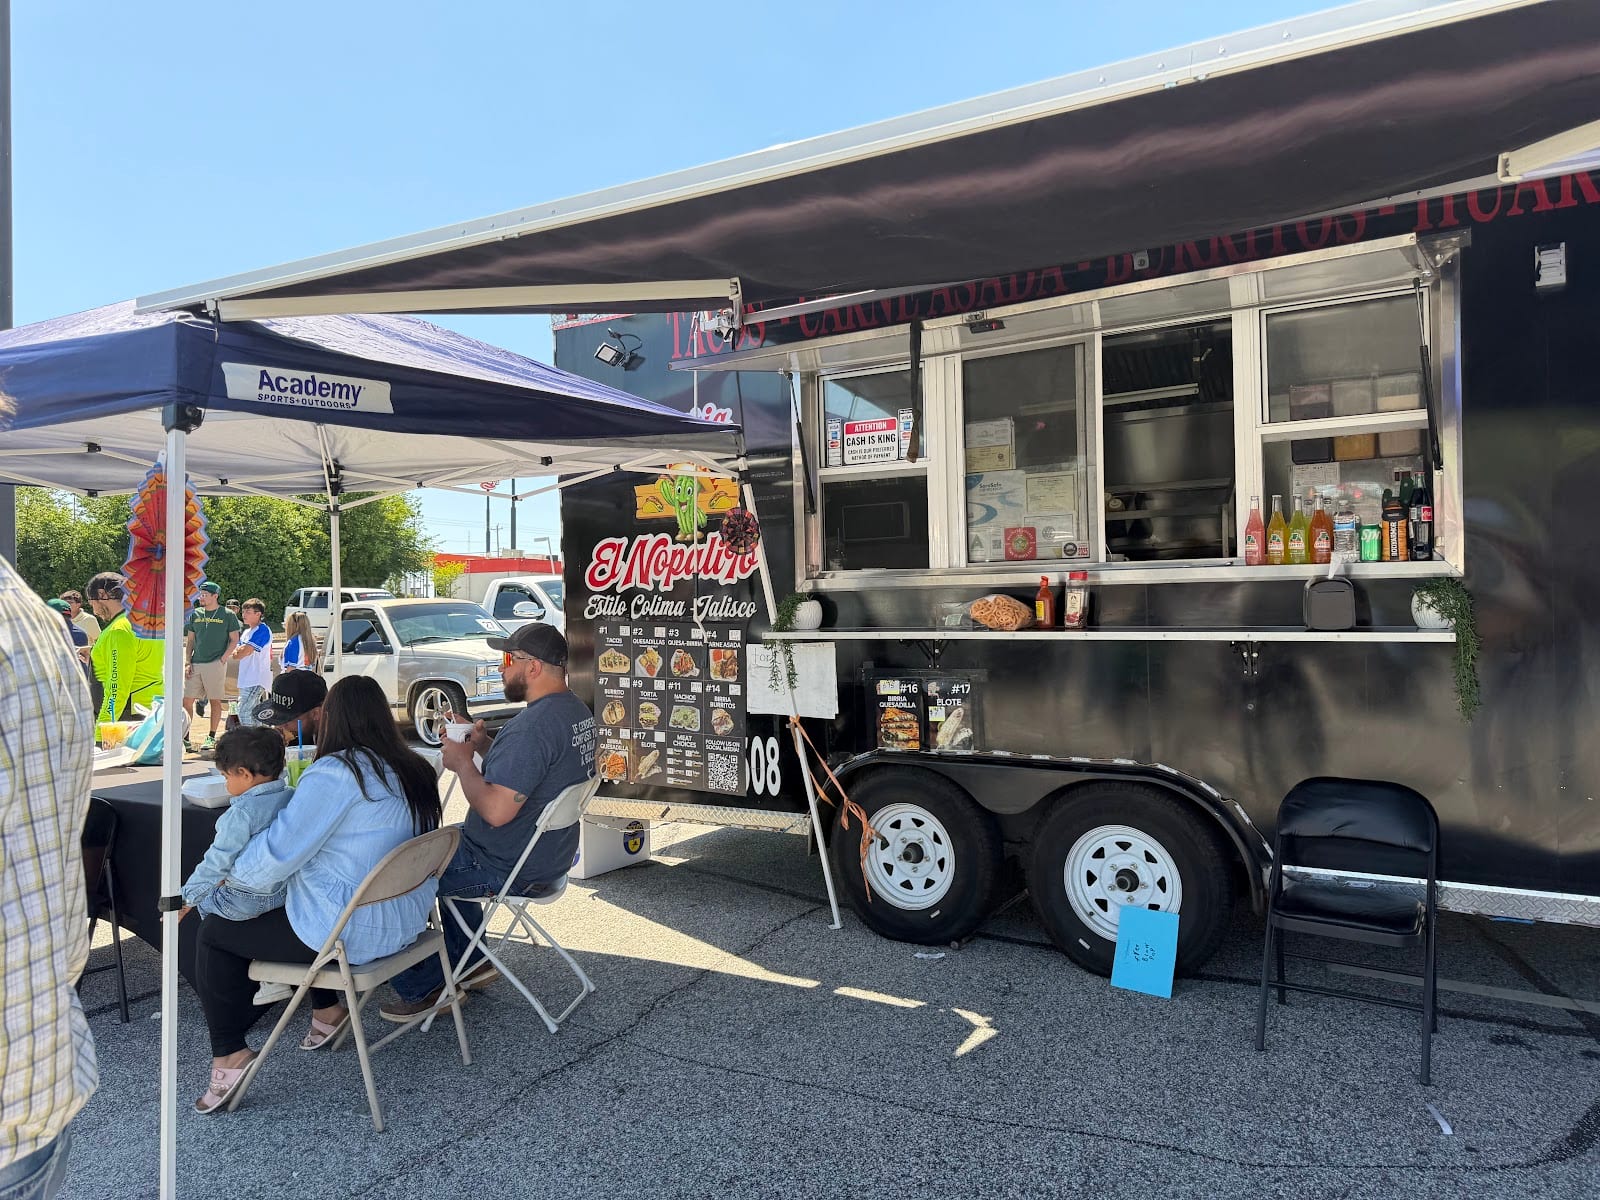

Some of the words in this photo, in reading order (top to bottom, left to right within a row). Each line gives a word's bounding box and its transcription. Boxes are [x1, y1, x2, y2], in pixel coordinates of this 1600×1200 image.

[258, 369, 362, 406] Academy
[854, 421, 887, 432] ATTENTION
[846, 436, 866, 446] CASH
[868, 435, 876, 445] IS
[877, 433, 896, 443] KING
[587, 540, 625, 589] El
[620, 536, 759, 589] Nopalio
[584, 595, 627, 619] Estilo
[631, 594, 686, 619] Colima
[696, 595, 757, 621] Jalisco
[598, 626, 608, 634] #1
[668, 628, 680, 637] #3
[706, 630, 717, 638] #4
[598, 677, 608, 686] #7
[632, 680, 643, 688] #9
[668, 682, 680, 690] #11
[705, 684, 720, 693] #14
[900, 684, 918, 694] #16
[951, 684, 970, 694] #17
[936, 698, 962, 706] ELOTE
[598, 728, 612, 736] #16
[632, 732, 646, 740] #17
[672, 740, 696, 748] CHOICES
[746, 736, 782, 796] 08
